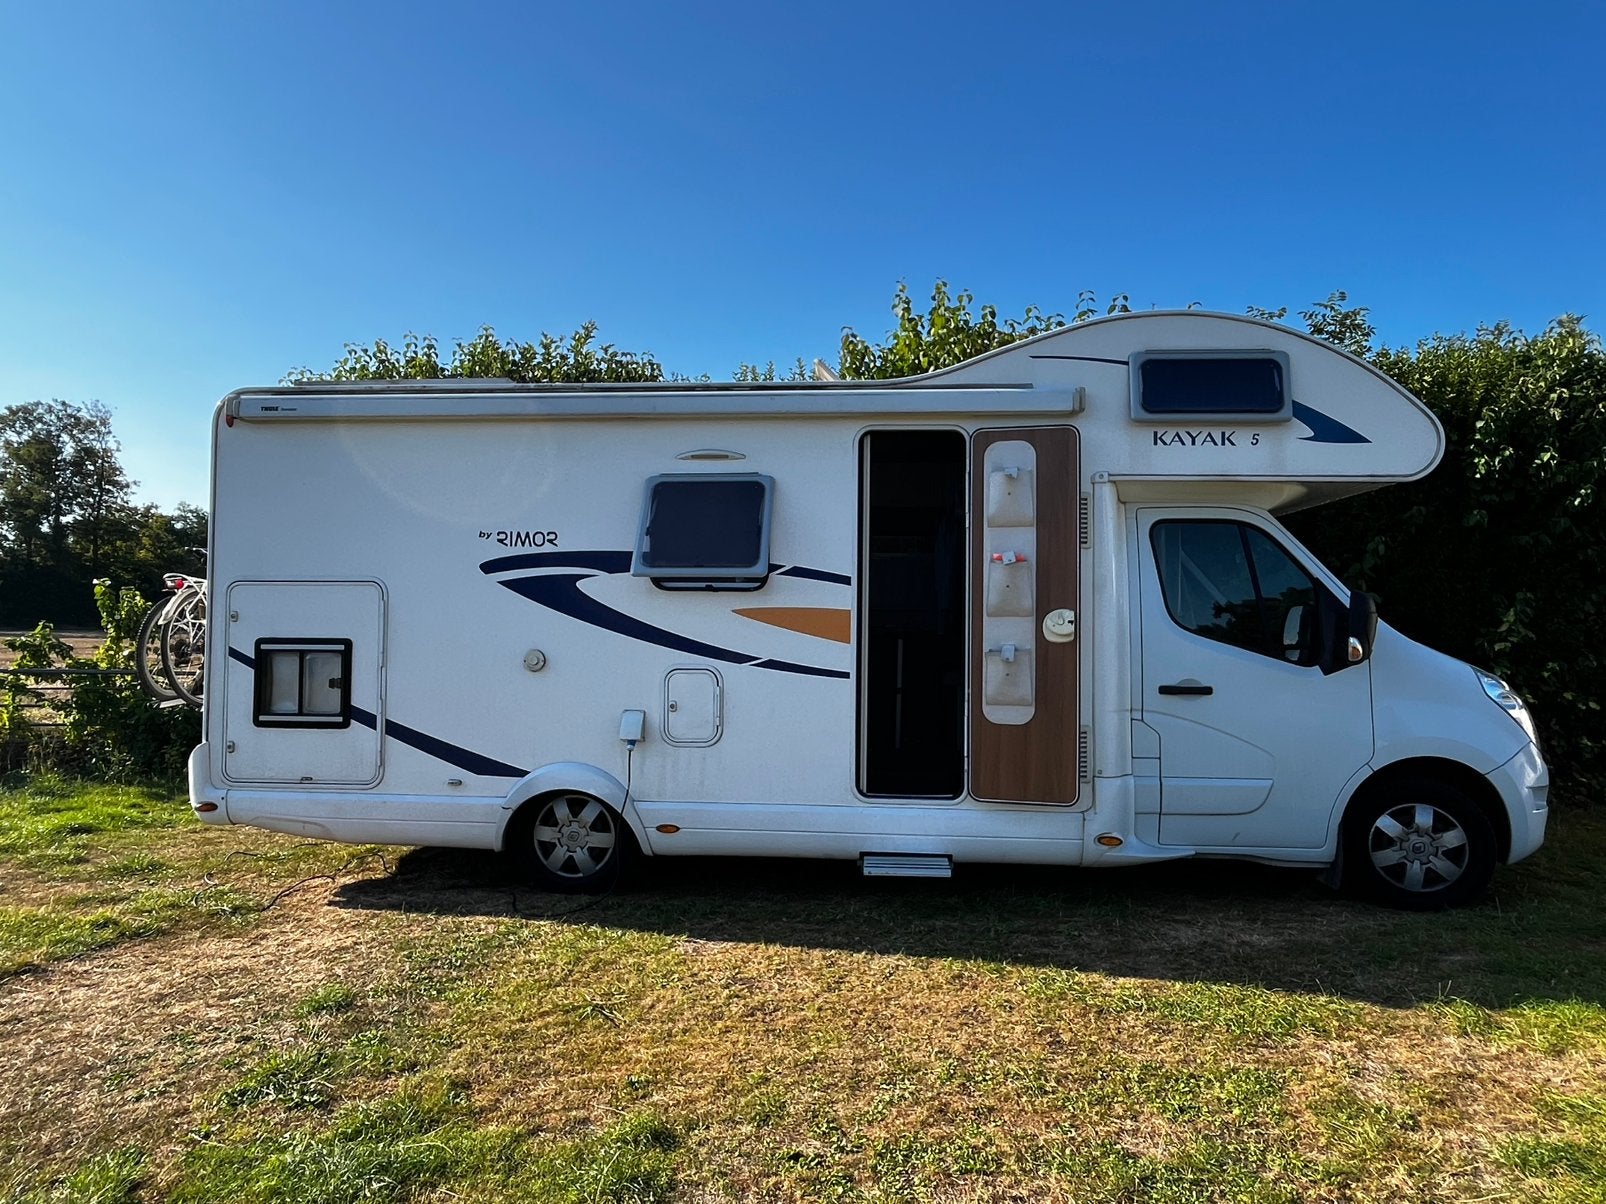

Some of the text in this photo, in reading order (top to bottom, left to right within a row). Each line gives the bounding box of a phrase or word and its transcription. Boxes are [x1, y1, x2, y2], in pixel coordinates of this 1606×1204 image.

[1153, 430, 1260, 446] KAYAK 5
[479, 530, 559, 547] by RIMOR
